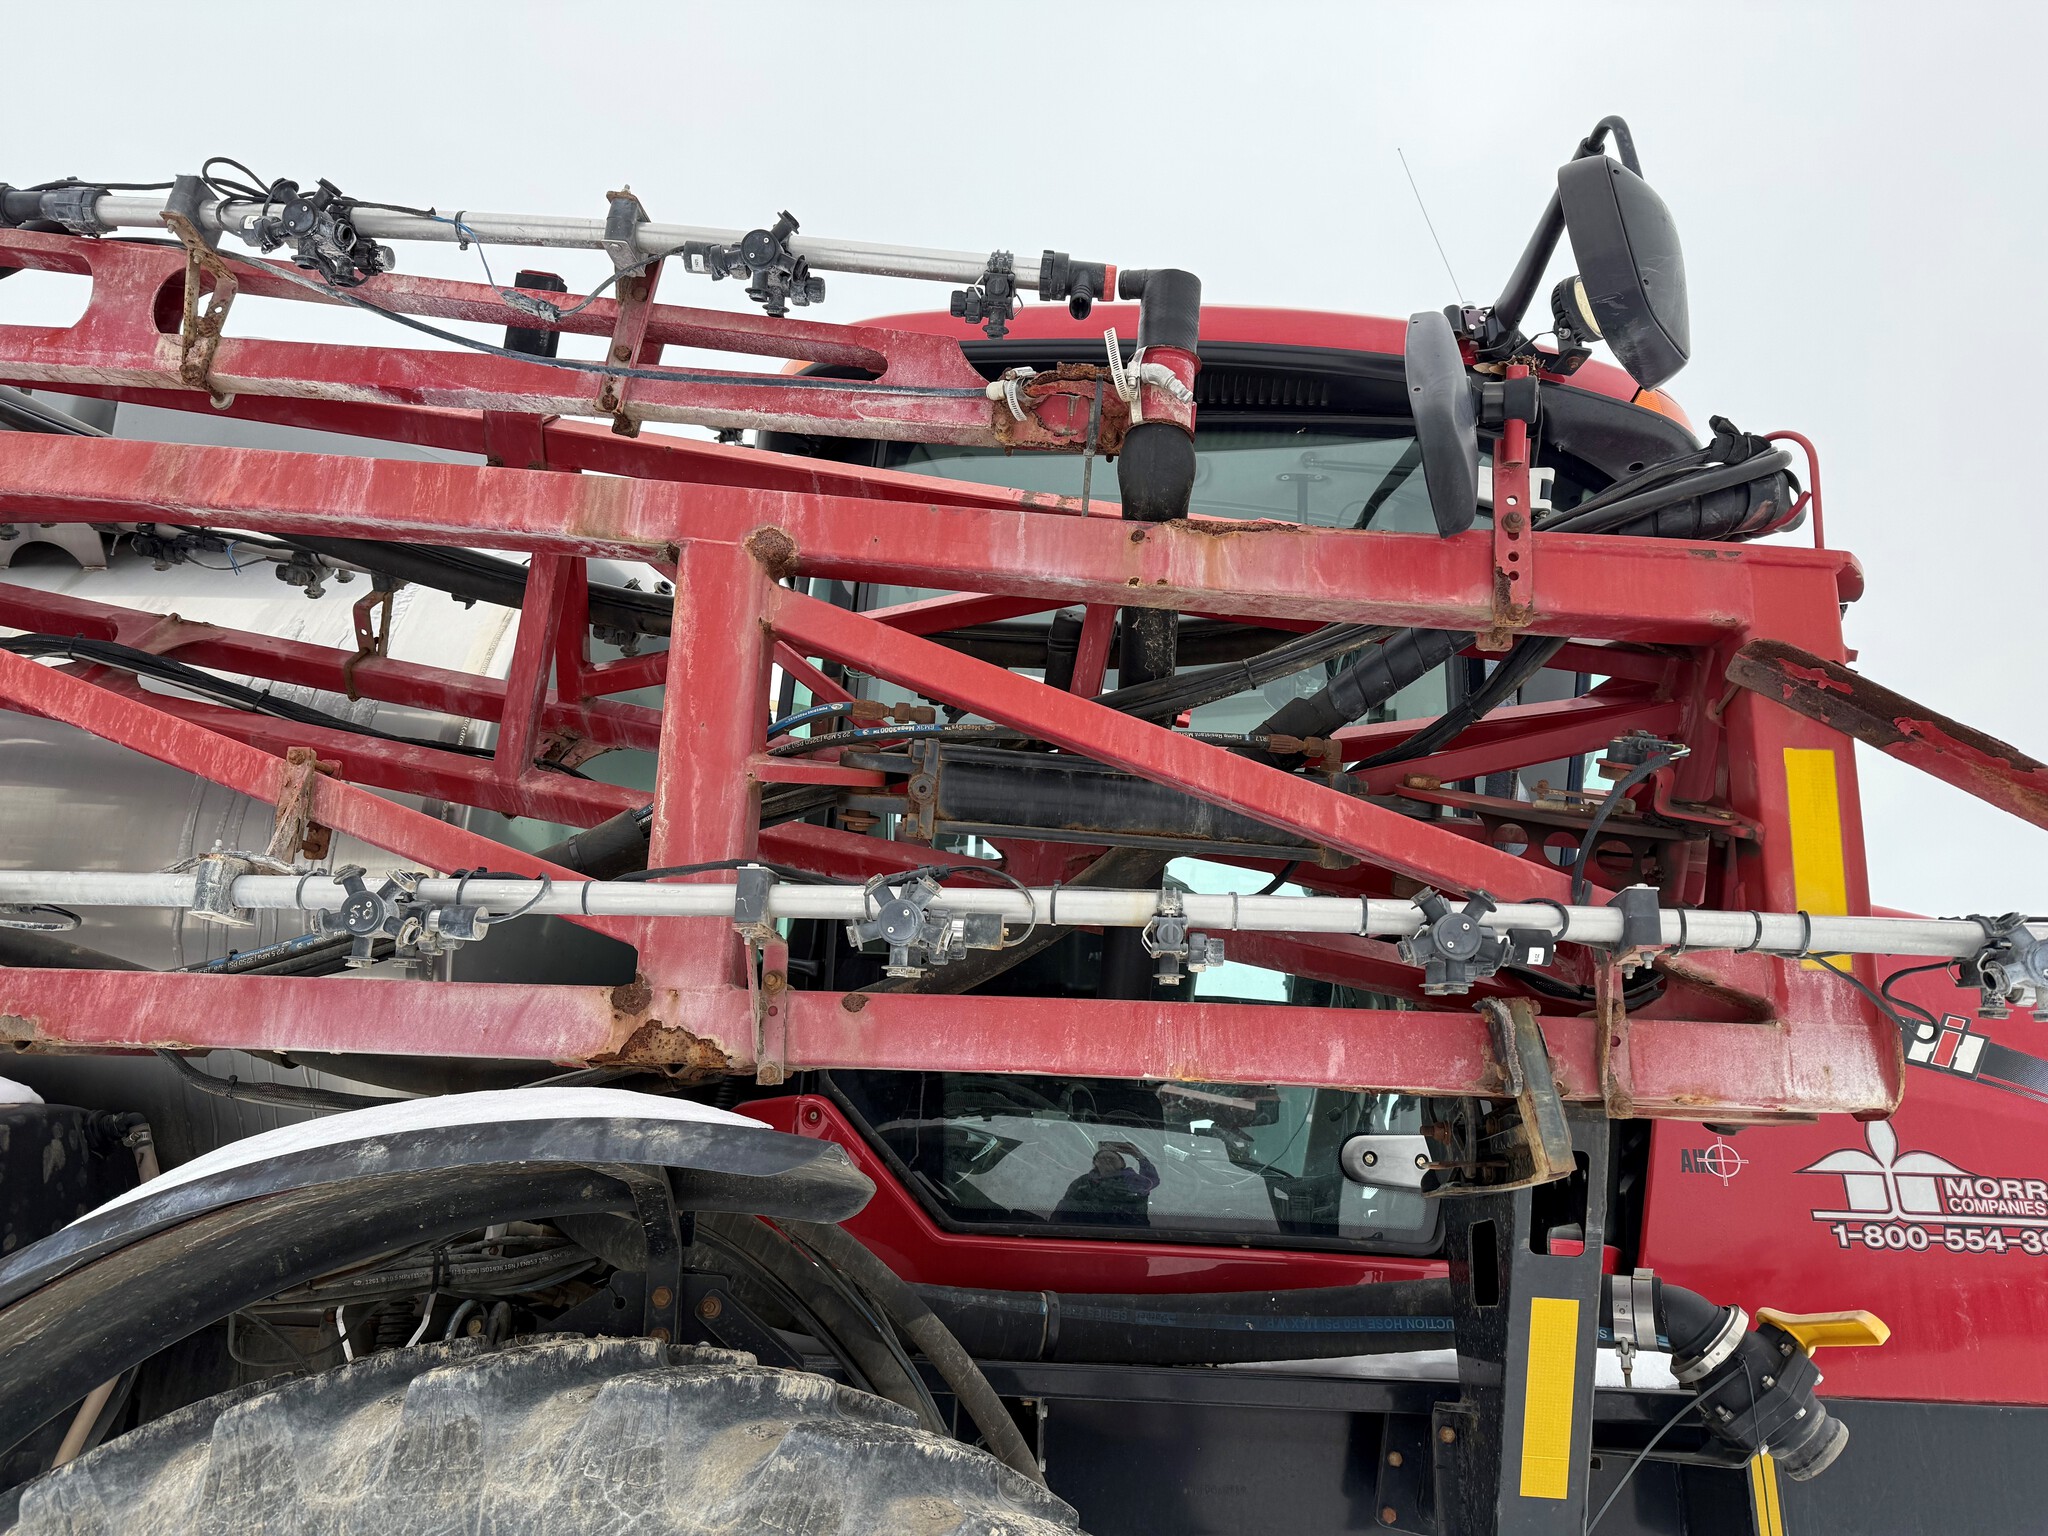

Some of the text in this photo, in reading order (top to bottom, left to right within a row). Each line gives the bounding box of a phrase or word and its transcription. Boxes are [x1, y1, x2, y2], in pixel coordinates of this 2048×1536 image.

[1948, 1197, 2048, 1217] COMPANIES
[1087, 1307, 1128, 1321] SERIES
[1290, 1317, 1318, 1330] MAX
[1321, 1318, 1341, 1329] PSI
[1344, 1318, 1364, 1329] 150
[1368, 1317, 1403, 1330] HOSE
[1407, 1317, 1456, 1330] UCTION
